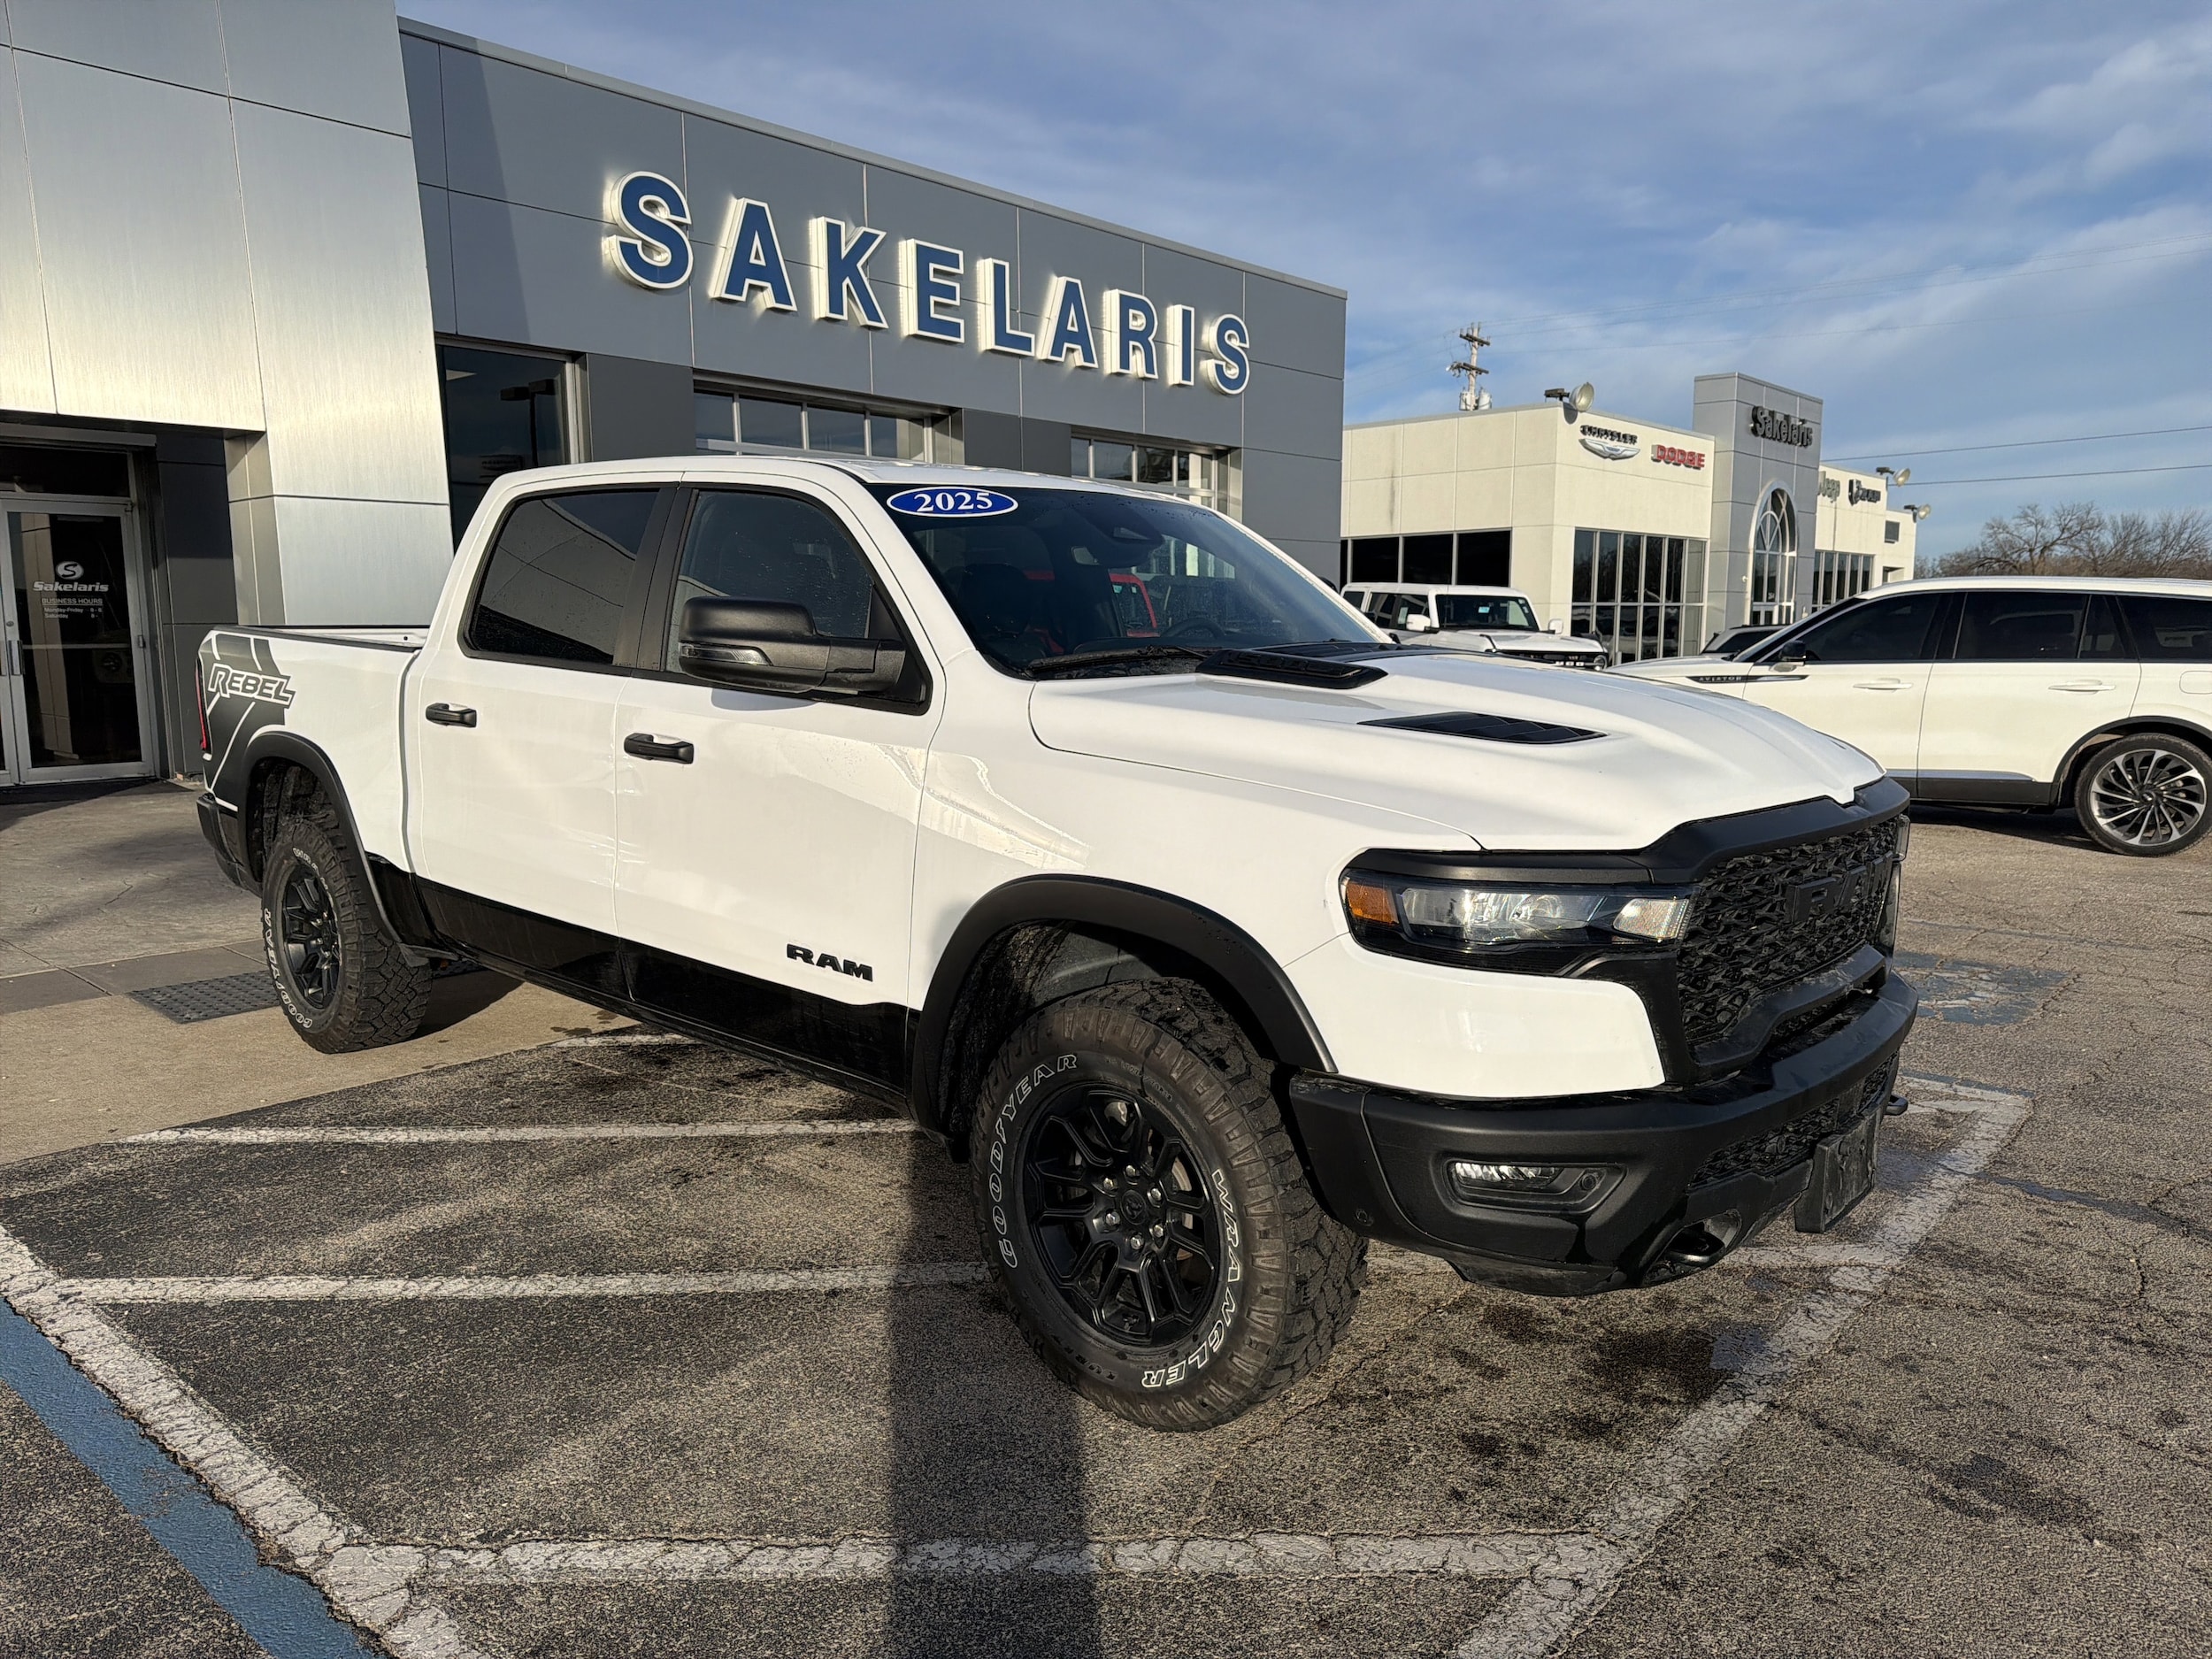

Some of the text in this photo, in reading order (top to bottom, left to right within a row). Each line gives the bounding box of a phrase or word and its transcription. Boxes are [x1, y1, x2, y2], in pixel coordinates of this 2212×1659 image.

[607, 171, 1250, 395] SAKELARIS
[1580, 425, 1638, 445] CHRYSLER
[1752, 405, 1813, 448] Sakelaris
[1651, 444, 1706, 470] DODGE
[914, 492, 993, 511] 2025
[33, 581, 109, 592] Sakelaris
[208, 663, 296, 708] REBEL
[787, 943, 873, 982] RAM
[988, 1054, 1077, 1268] GOODYEAR
[1141, 1168, 1240, 1388] WRANGLER
